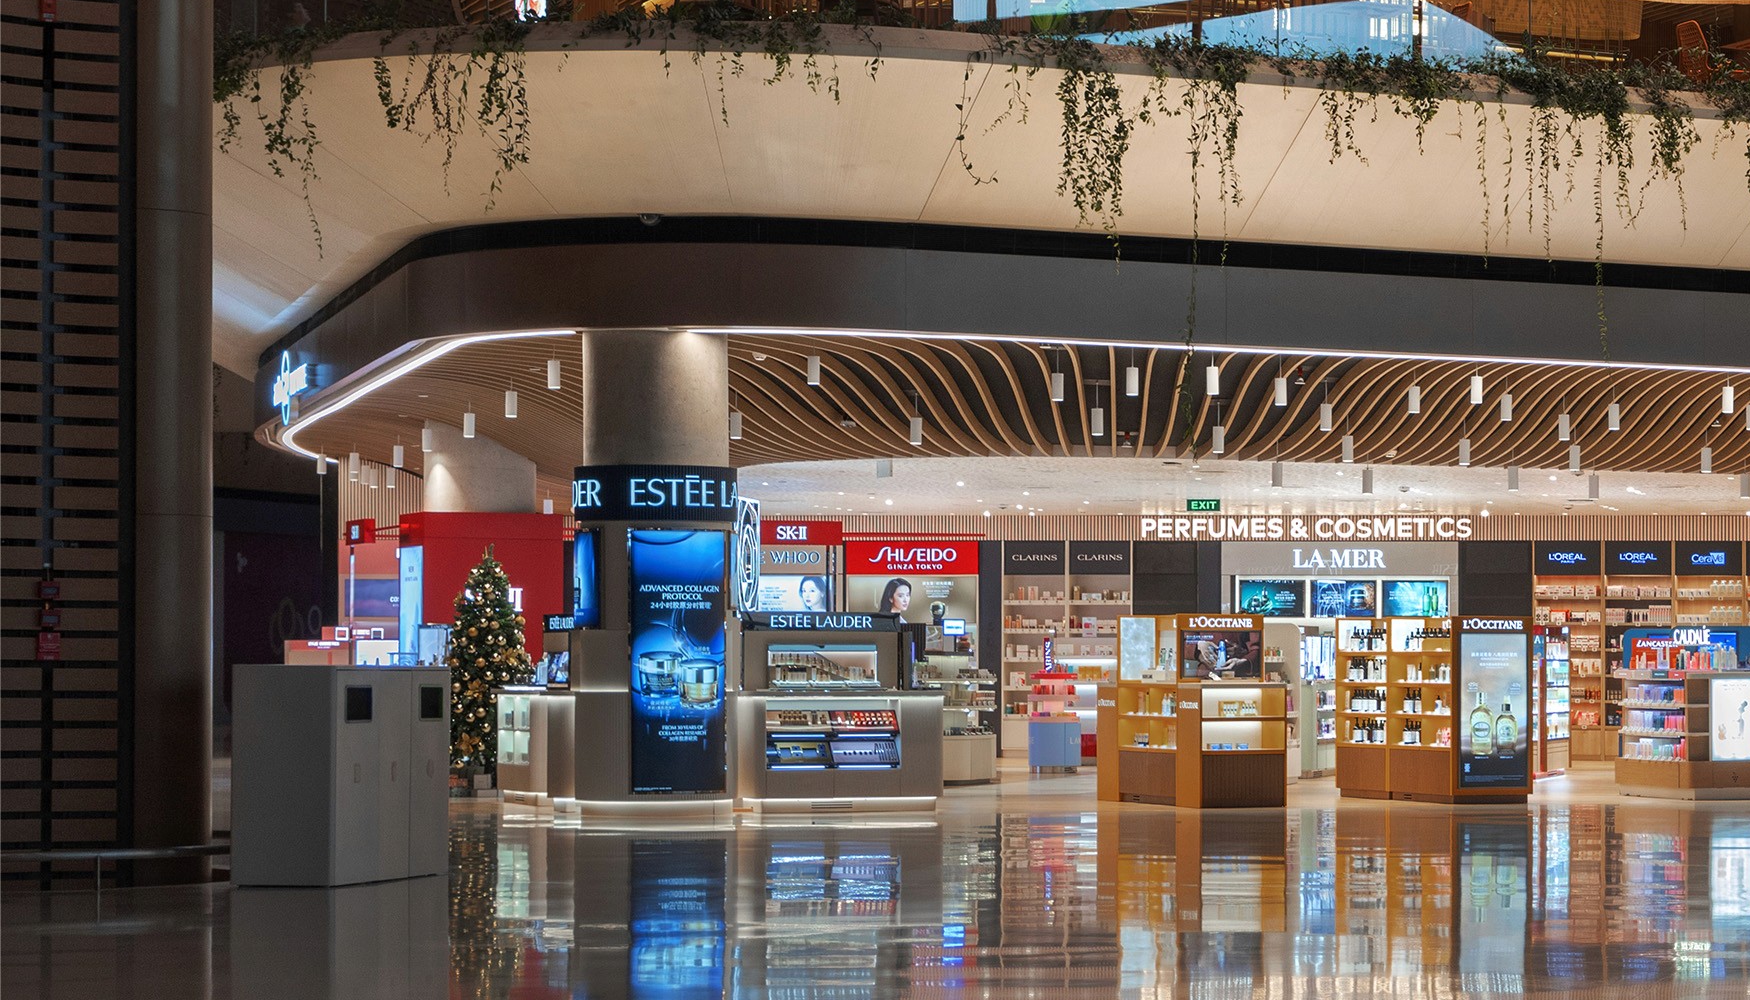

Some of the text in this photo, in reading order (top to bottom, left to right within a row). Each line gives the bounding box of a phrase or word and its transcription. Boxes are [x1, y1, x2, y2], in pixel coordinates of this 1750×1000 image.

[1190, 501, 1217, 510] EXIT
[1141, 517, 1472, 539] PERFUMES & COSMETICS
[770, 551, 821, 564] WHOO
[868, 546, 957, 563] SHISEIDO
[1292, 549, 1326, 569] LA
[1330, 549, 1386, 569] MER
[639, 584, 720, 593] ADVANCED COLLAGEN
[816, 616, 872, 628] LAUDER
